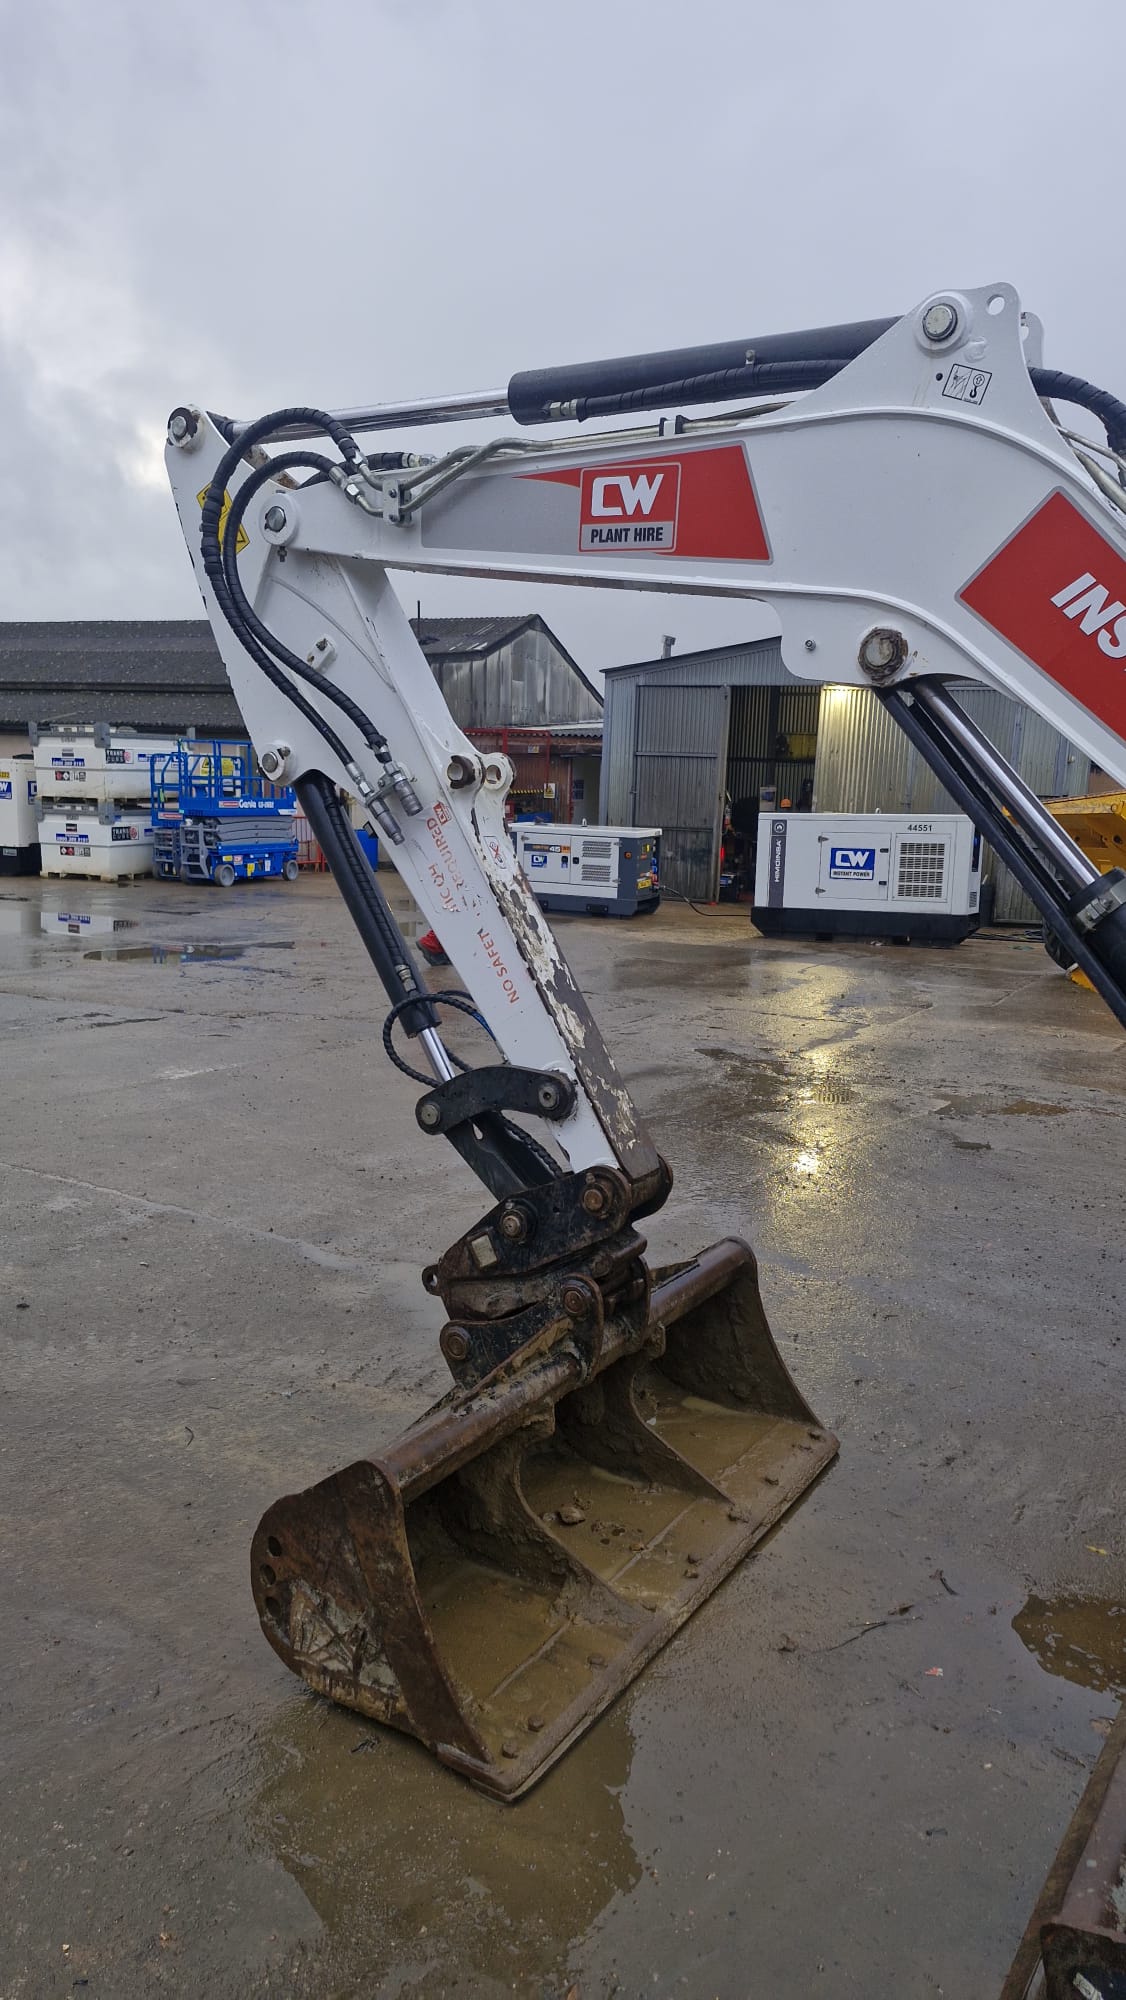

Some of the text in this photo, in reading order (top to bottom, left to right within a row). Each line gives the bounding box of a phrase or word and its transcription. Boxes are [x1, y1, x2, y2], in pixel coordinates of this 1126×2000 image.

[591, 473, 665, 517] CW
[590, 526, 664, 544] PLANT HIRE
[1050, 572, 1126, 662] INS
[239, 799, 257, 809] Genie
[907, 824, 932, 832] 44551
[835, 850, 870, 867] CW
[477, 928, 520, 1004] NO SAFET
